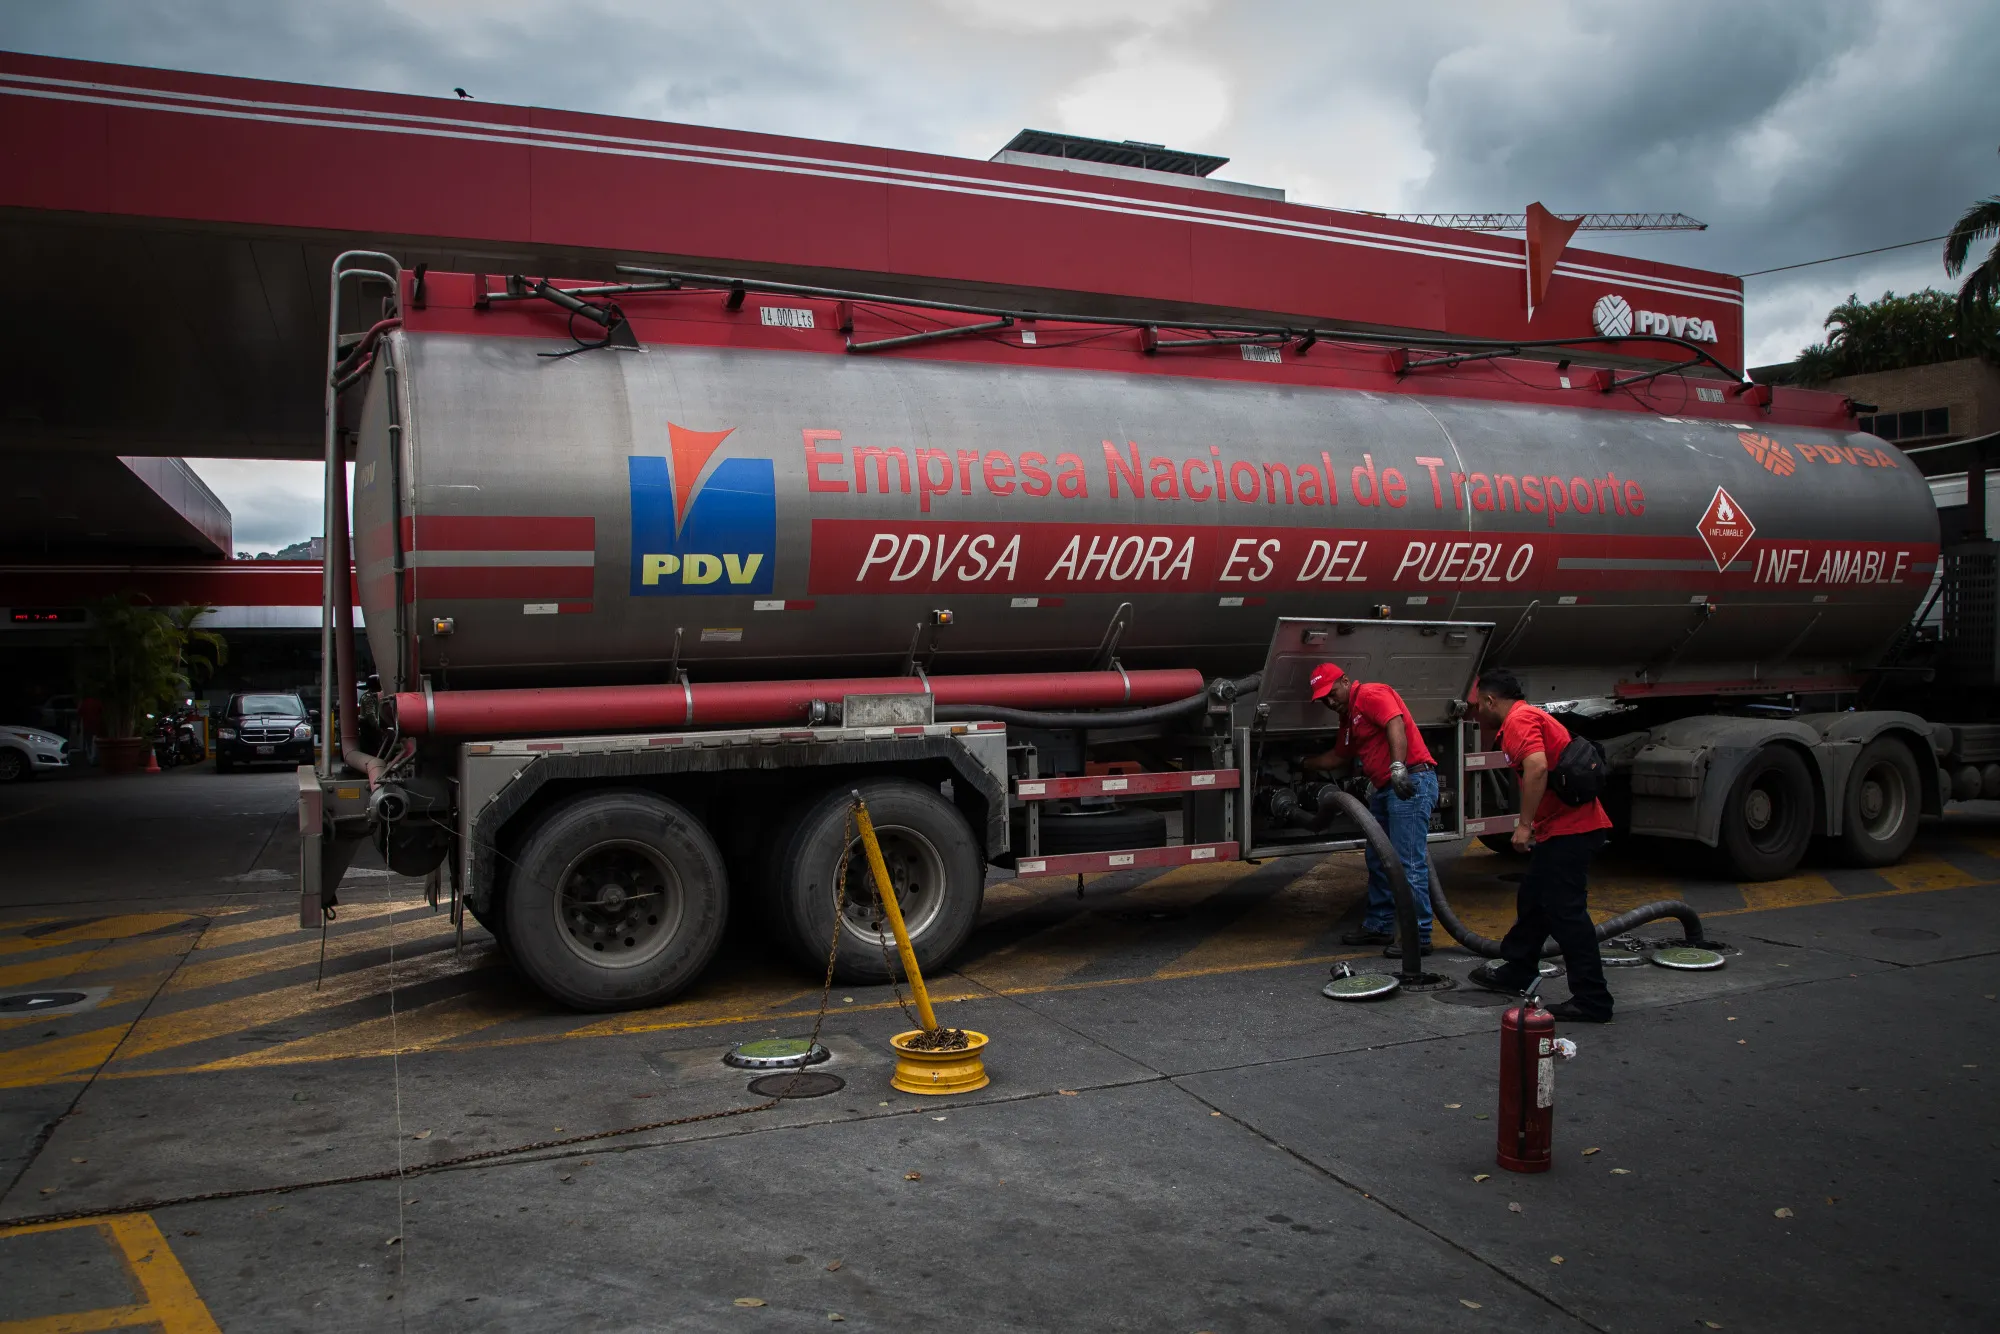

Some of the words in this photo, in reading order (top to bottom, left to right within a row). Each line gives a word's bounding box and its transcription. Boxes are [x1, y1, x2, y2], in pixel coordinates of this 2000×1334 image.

[761, 307, 793, 327] 14.000
[796, 309, 813, 328] Lts
[1635, 310, 1718, 343] PDVSA
[1793, 443, 1899, 468] PDVSA
[802, 428, 1089, 513] Empresa
[1101, 440, 1338, 506] Nacional
[1351, 453, 1408, 508] de
[1415, 456, 1646, 527] Transporte
[1709, 528, 1744, 537] INFLAMABLE
[642, 553, 765, 585] PDV
[856, 533, 1021, 582] PDVSA
[1045, 534, 1195, 581] AHORA
[1219, 538, 1281, 582] ES
[1296, 540, 1368, 582] DEL
[1393, 541, 1534, 582] PUEBLO
[1721, 551, 1727, 560] 3
[1753, 549, 1910, 584] INFLAMABLE
